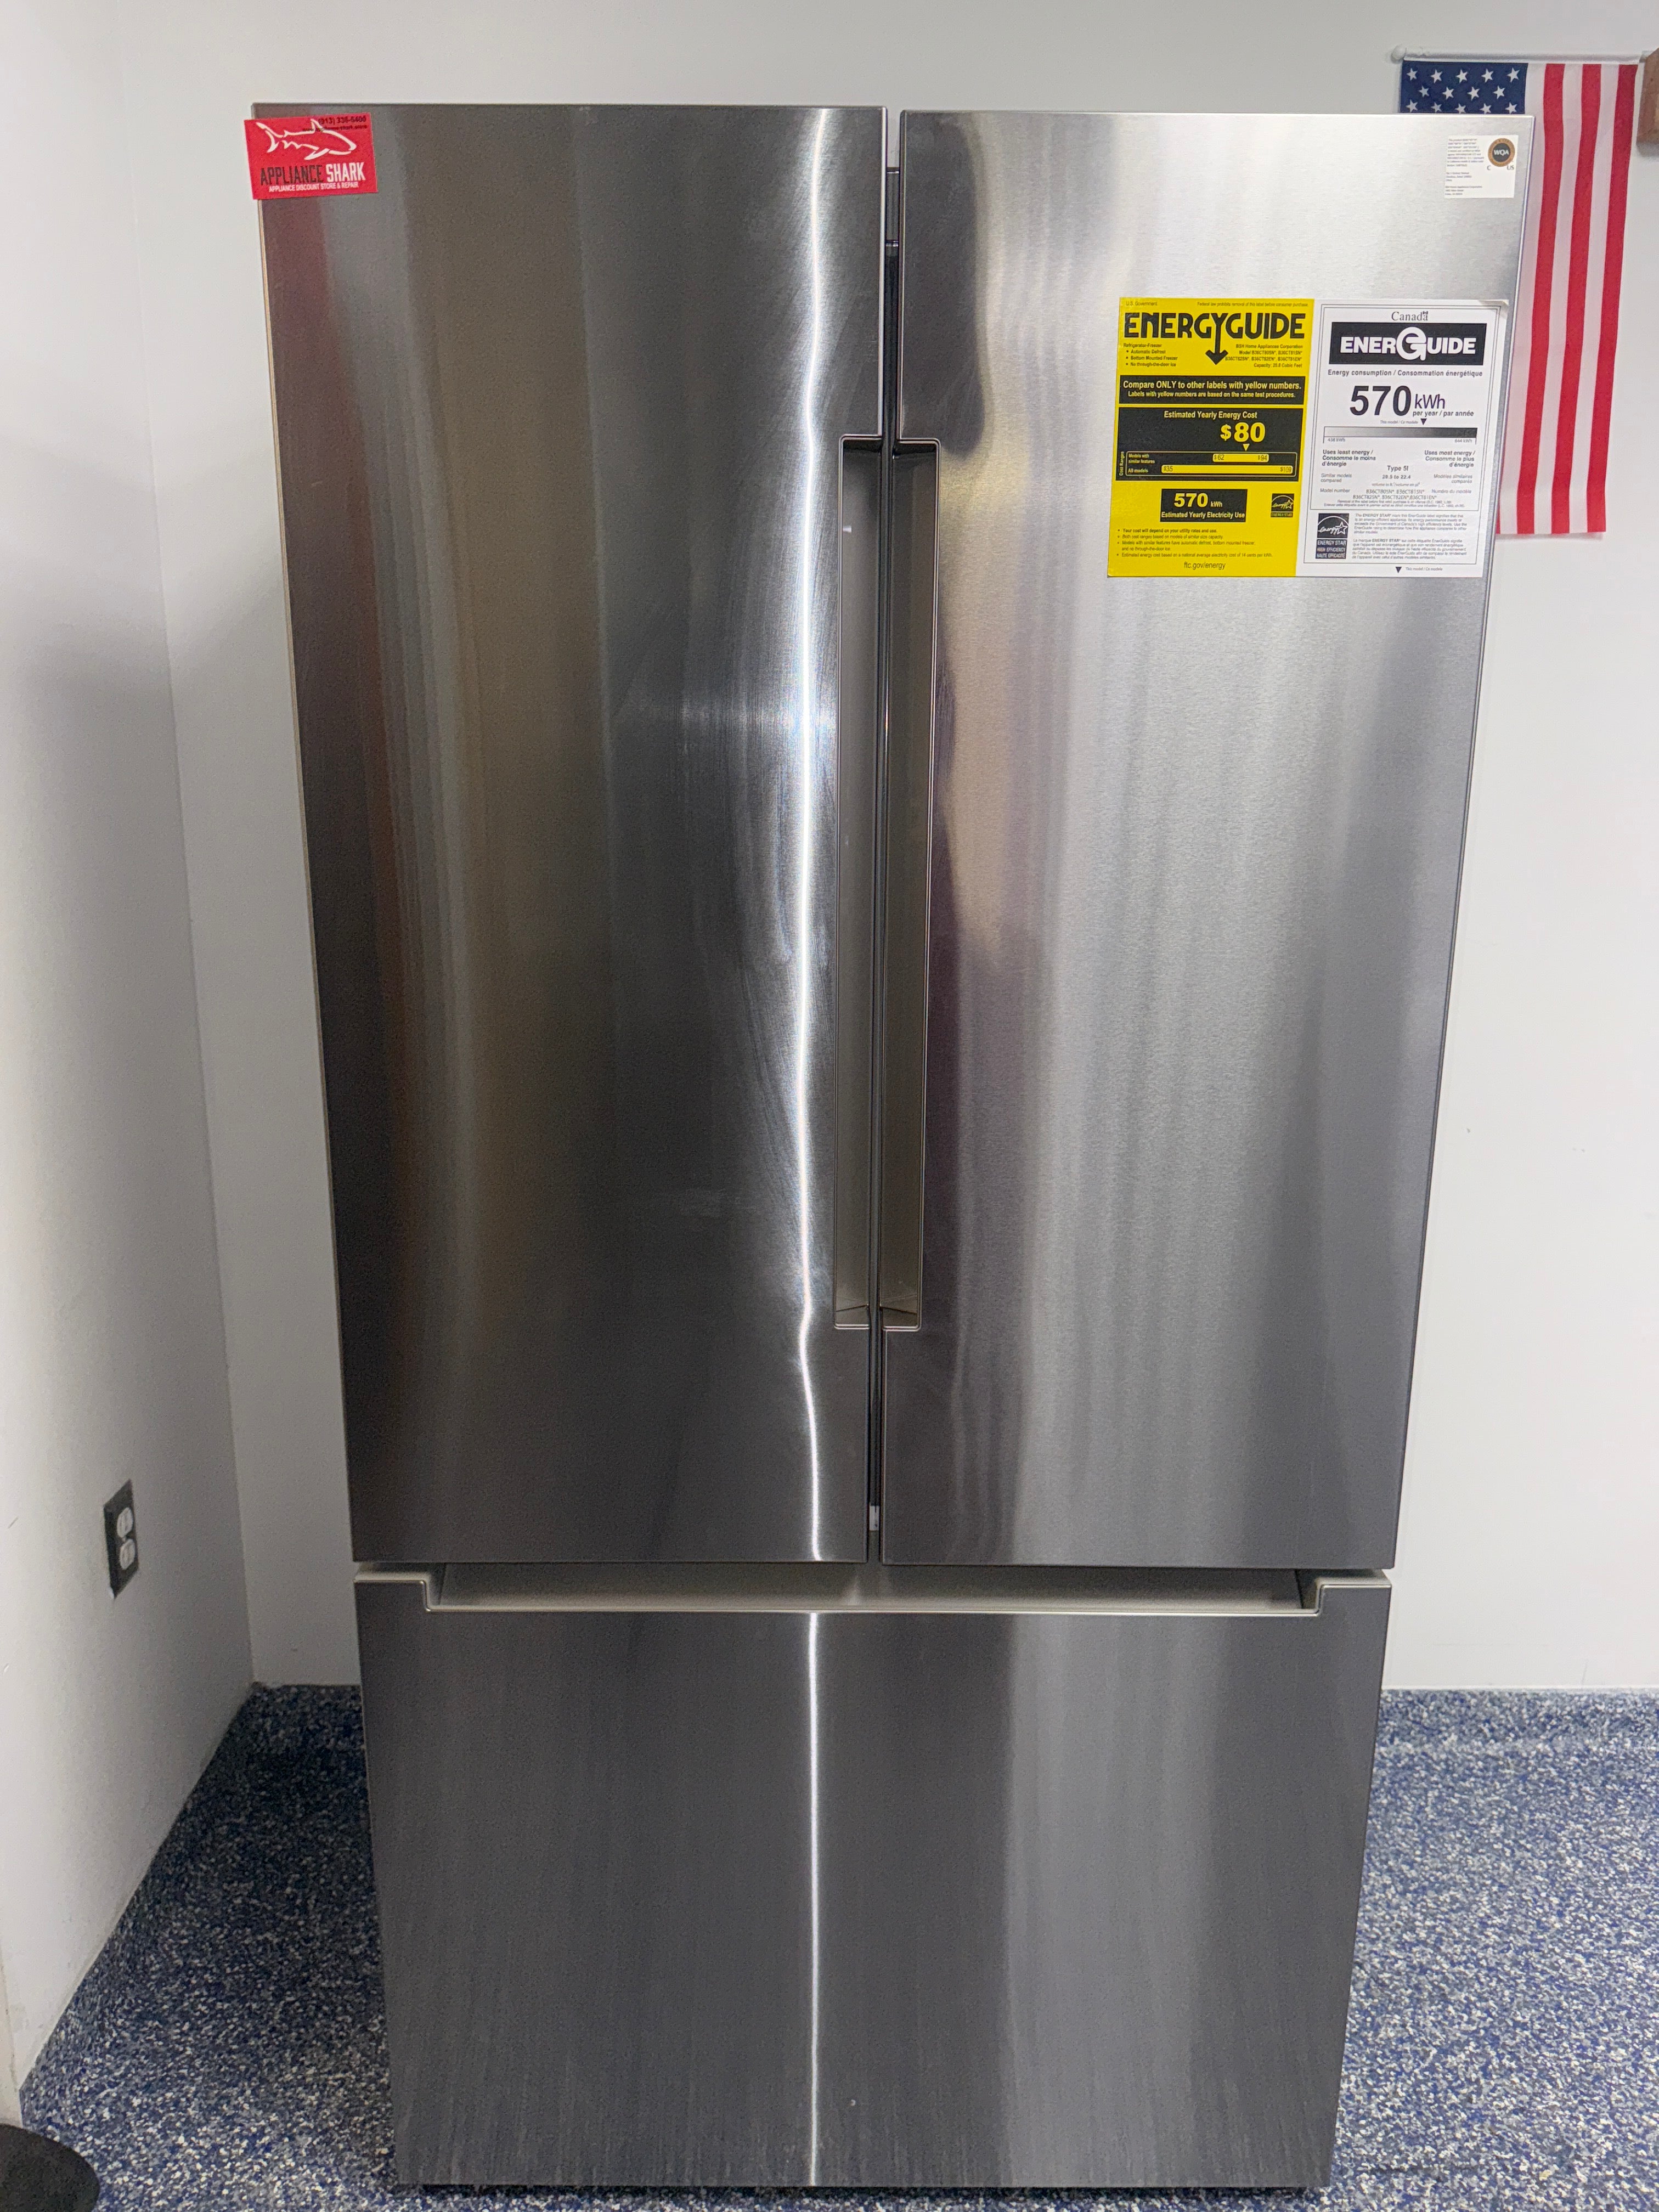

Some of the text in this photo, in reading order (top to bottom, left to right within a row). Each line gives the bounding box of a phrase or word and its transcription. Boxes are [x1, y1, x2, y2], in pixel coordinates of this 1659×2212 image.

[261, 162, 365, 185] APPLIANCE SHARK
[1392, 312, 1428, 321] Canada
[1124, 312, 1306, 339] ENERGYGUIDE
[1340, 327, 1476, 360] ENERGUIDE
[1123, 381, 1154, 390] Compare
[1207, 381, 1227, 389] labels
[1245, 381, 1267, 390] yellow
[1350, 385, 1445, 416] 570 kWh
[1197, 411, 1217, 420] Yearly
[1218, 411, 1240, 420] Energy
[1220, 422, 1266, 442] $80
[1174, 493, 1208, 507] 570
[1184, 562, 1226, 570] ftc.gov/energy
